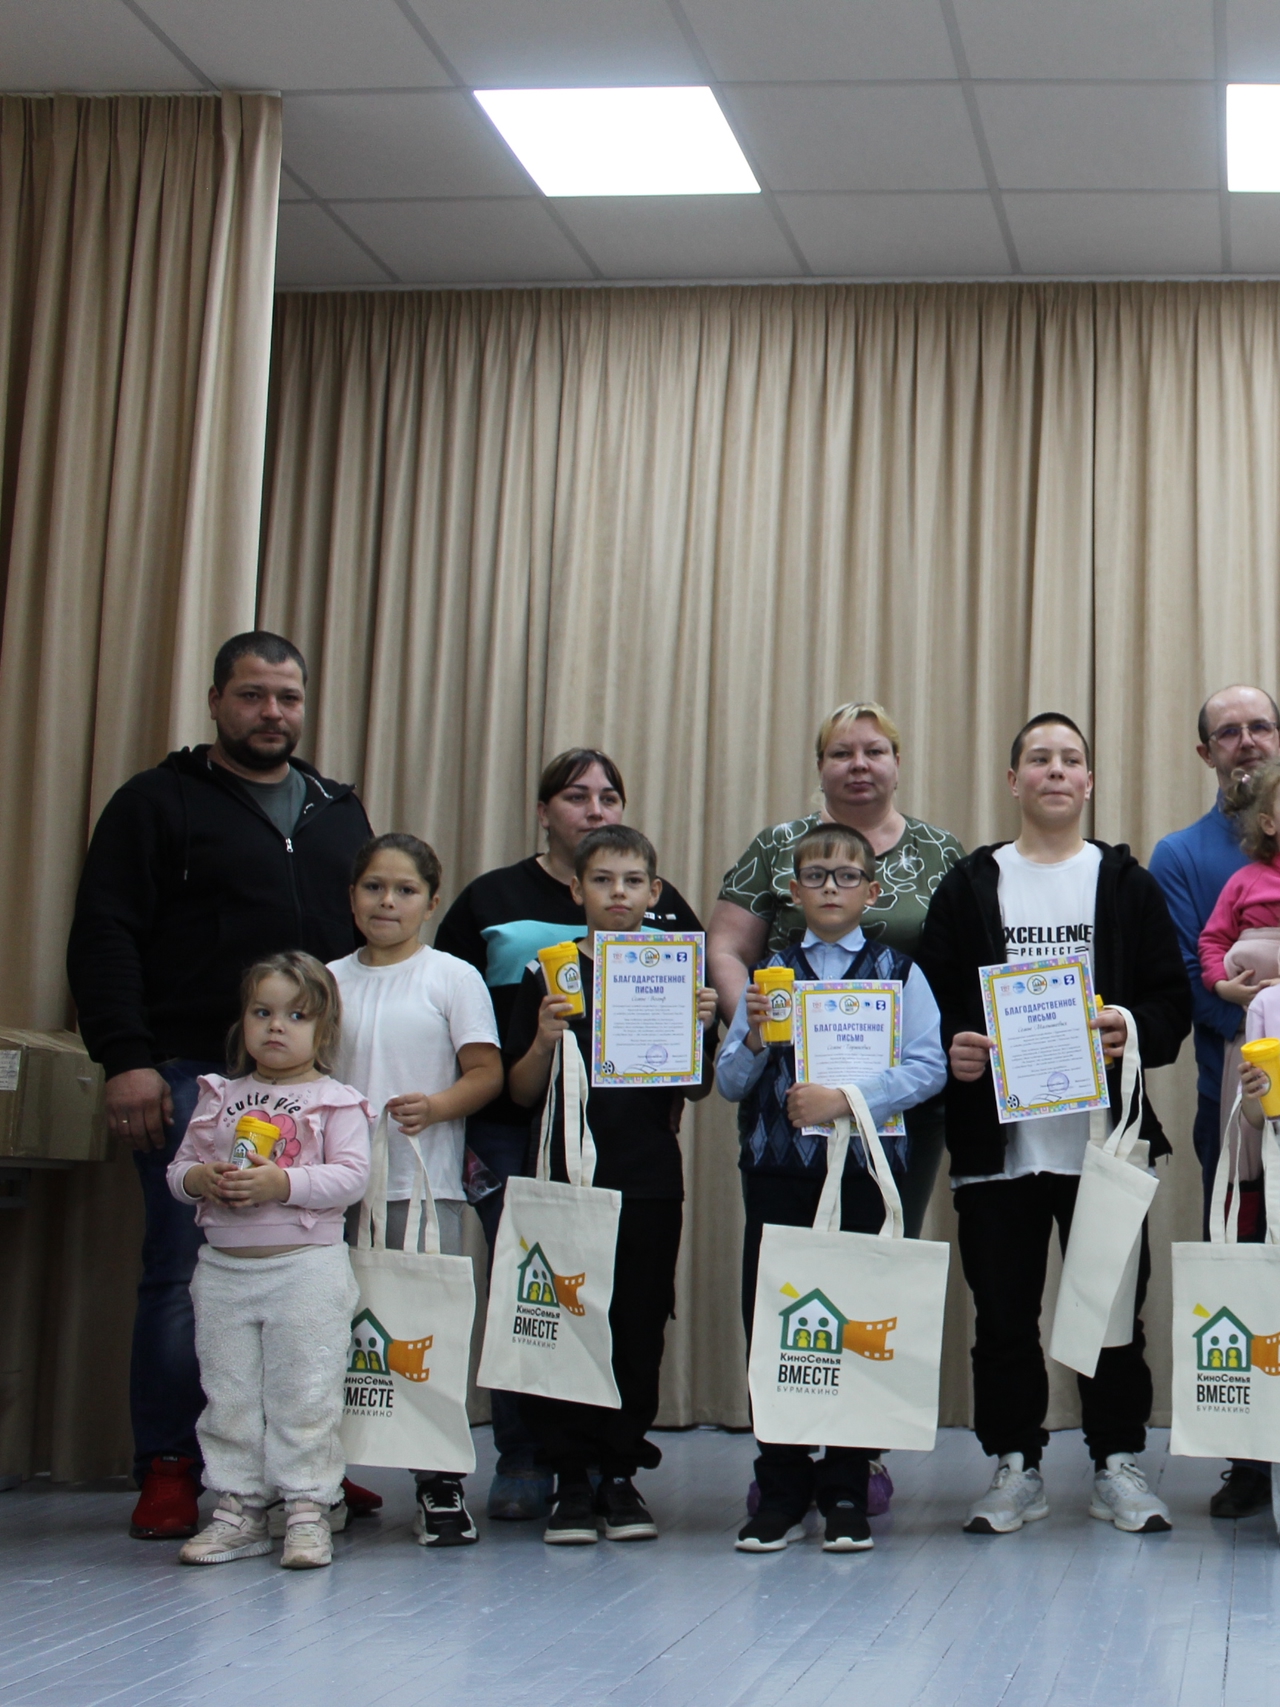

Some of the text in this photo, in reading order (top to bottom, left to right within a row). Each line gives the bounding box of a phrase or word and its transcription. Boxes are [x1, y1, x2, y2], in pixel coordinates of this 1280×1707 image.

[1004, 923, 1093, 944] XCELLENCE
[1020, 946, 1071, 956] PERFECT
[613, 975, 686, 984] БЛАГОДАРСТВЕННОЕ
[635, 986, 664, 994] ПИСЬМО
[1004, 998, 1077, 1016] БЛАГОДАРСТВЕННОЕ
[1027, 1012, 1057, 1023] ПИСЬМО
[814, 1023, 884, 1033] БЛАГОДАРСТВЕННОЕ
[836, 1033, 864, 1042] ПИСЬМО
[226, 1092, 301, 1116] cutie pie
[516, 1304, 560, 1319] КиноСемья
[513, 1316, 559, 1341] ВМЕСТЕ
[780, 1352, 841, 1366] КиноСемья
[345, 1375, 394, 1386] иноСемья
[778, 1364, 841, 1387] ВМЕСТЕ
[1197, 1373, 1251, 1383] КиноСемья
[777, 1385, 838, 1396] БУРМАКИНО
[1197, 1384, 1251, 1405] ВМЕСТЕ
[343, 1387, 394, 1408] МЕСТЕ
